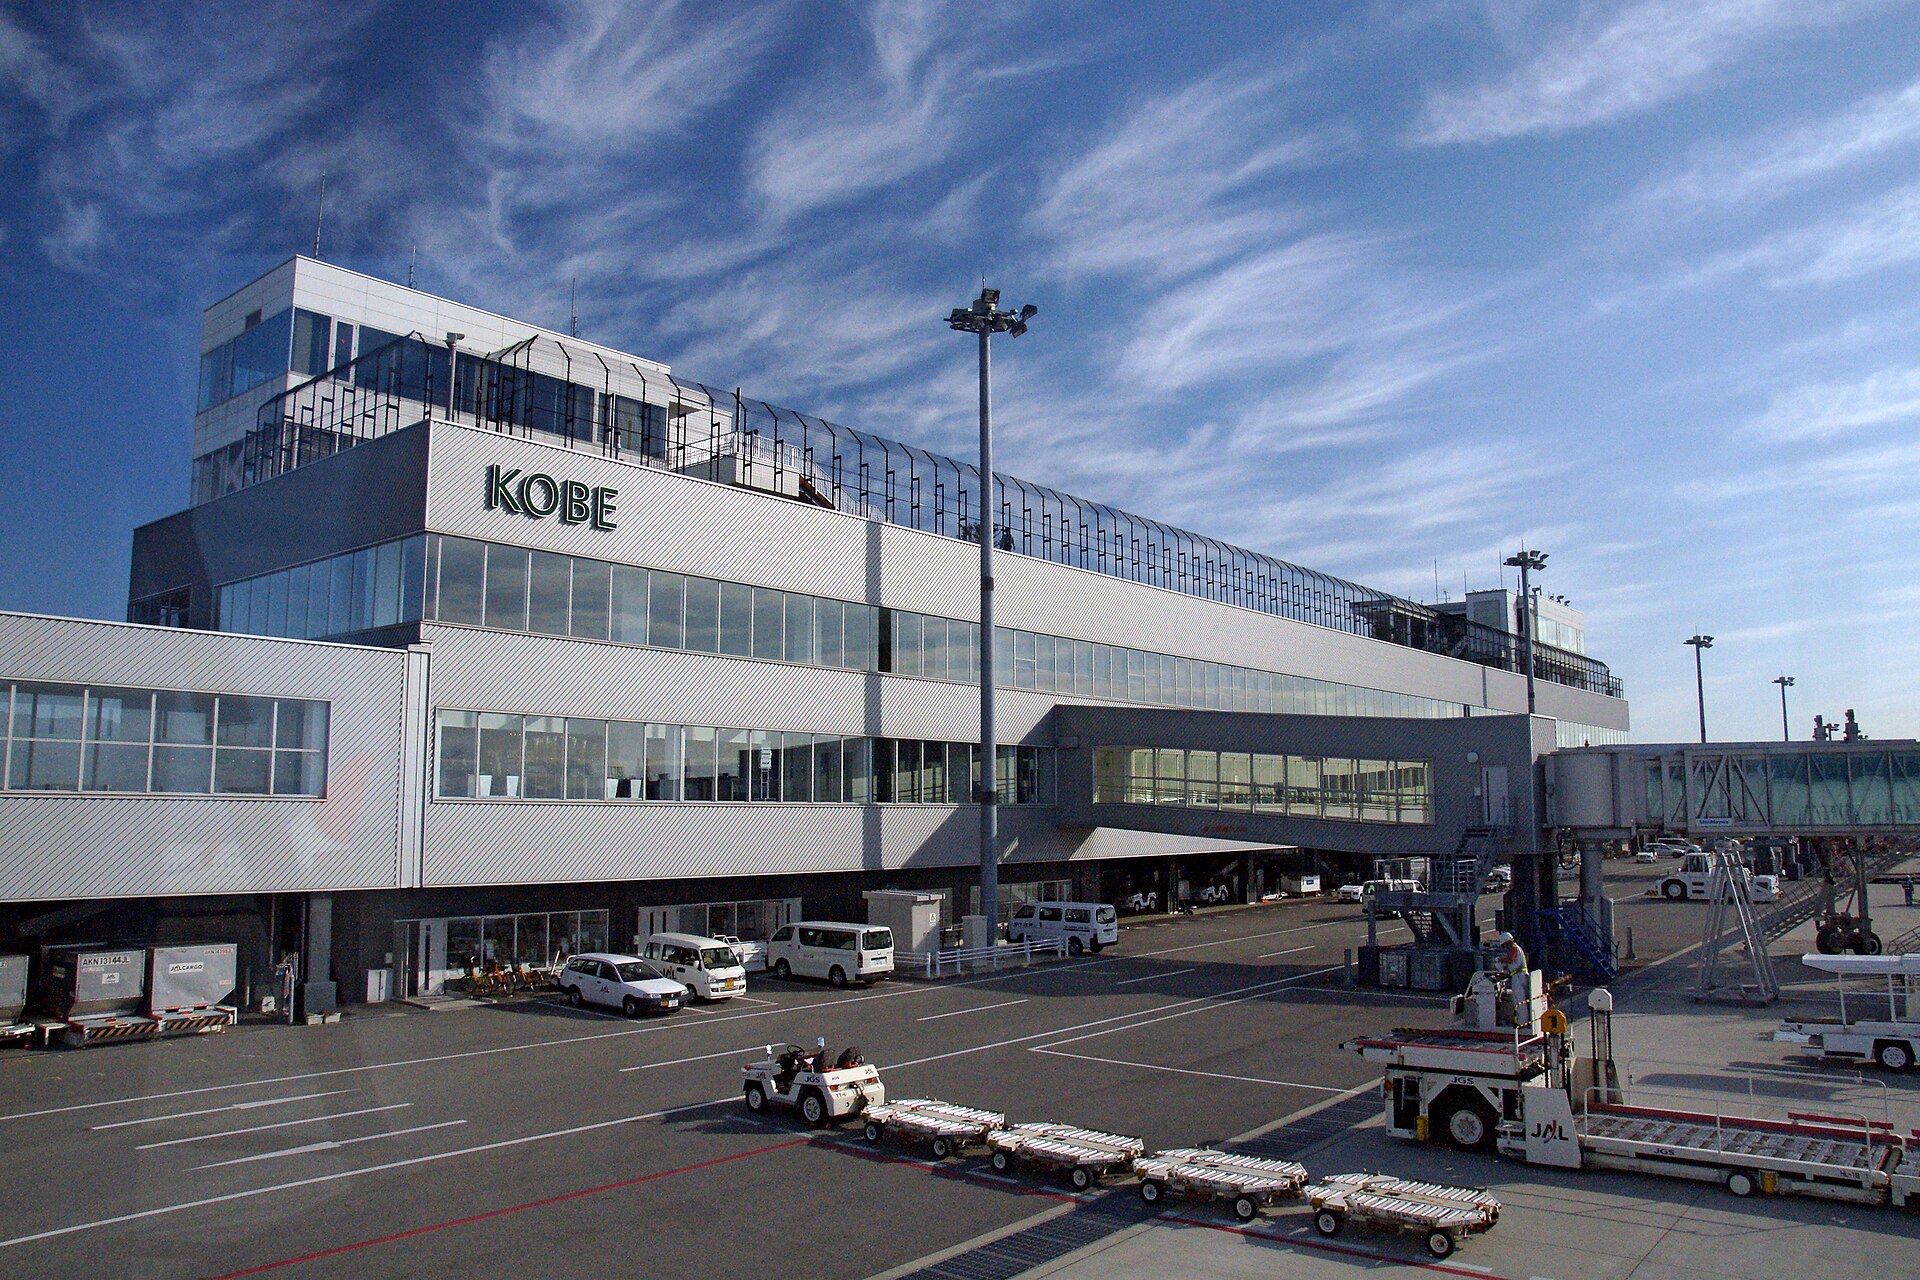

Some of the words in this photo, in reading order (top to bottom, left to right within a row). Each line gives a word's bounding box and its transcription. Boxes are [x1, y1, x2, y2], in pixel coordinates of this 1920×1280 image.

[489, 463, 619, 530] KOBE
[1547, 1015, 1557, 1029] 1
[804, 1075, 820, 1083] JGS
[1450, 1076, 1475, 1085] JGS
[1530, 1119, 1569, 1144] JAL
[1654, 1148, 1675, 1156] JGS
